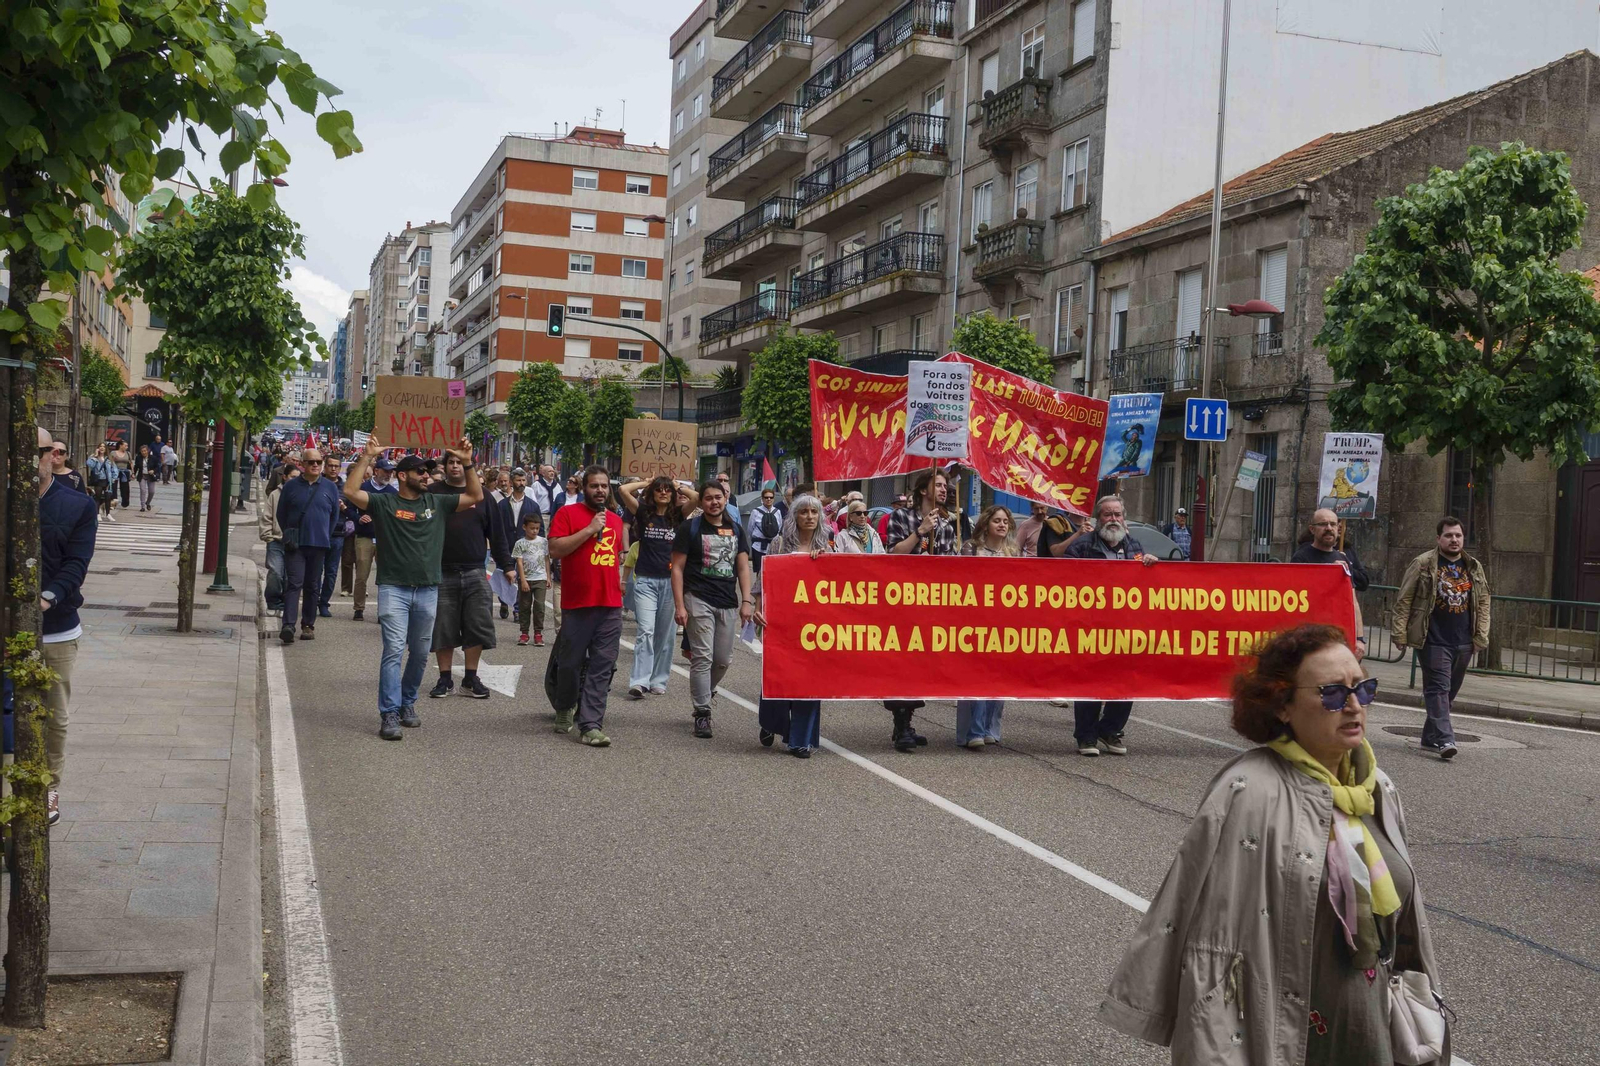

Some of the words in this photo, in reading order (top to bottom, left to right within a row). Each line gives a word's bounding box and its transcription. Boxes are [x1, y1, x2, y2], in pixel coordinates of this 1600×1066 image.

[923, 370, 946, 379] Fora
[816, 374, 852, 392] COS
[927, 380, 965, 390] fondos
[394, 392, 459, 410] CAPITALISMO
[926, 391, 965, 401] Voitres
[1117, 397, 1152, 408] TRUMP,
[910, 400, 928, 409] dos
[930, 402, 964, 411] nosos
[1018, 389, 1104, 427] ¡UNIDADE!
[924, 412, 963, 422] barrios
[390, 411, 461, 447] MATA!!
[664, 430, 682, 441] QUE
[631, 438, 690, 459] PARAR
[987, 412, 1099, 474] Maio!!
[1333, 438, 1372, 448] TRUMP,
[1031, 474, 1091, 506] UCE
[590, 553, 616, 567] UCE
[793, 580, 809, 604] A
[815, 580, 878, 605] CLASE
[885, 582, 978, 607] OBREIRA
[984, 584, 995, 607] E
[1001, 584, 1028, 608] OS
[1035, 585, 1107, 609] POBOS
[1112, 586, 1142, 610] DO
[1148, 587, 1226, 611] MUNDO
[1232, 589, 1310, 613] UNIDOS
[800, 623, 901, 651] CONTRA
[907, 625, 924, 652] A
[932, 626, 1071, 654] DICTADURA
[1077, 628, 1184, 655] MUNDIAL
[1190, 630, 1220, 656] DE
[1225, 630, 1277, 656] TRU
